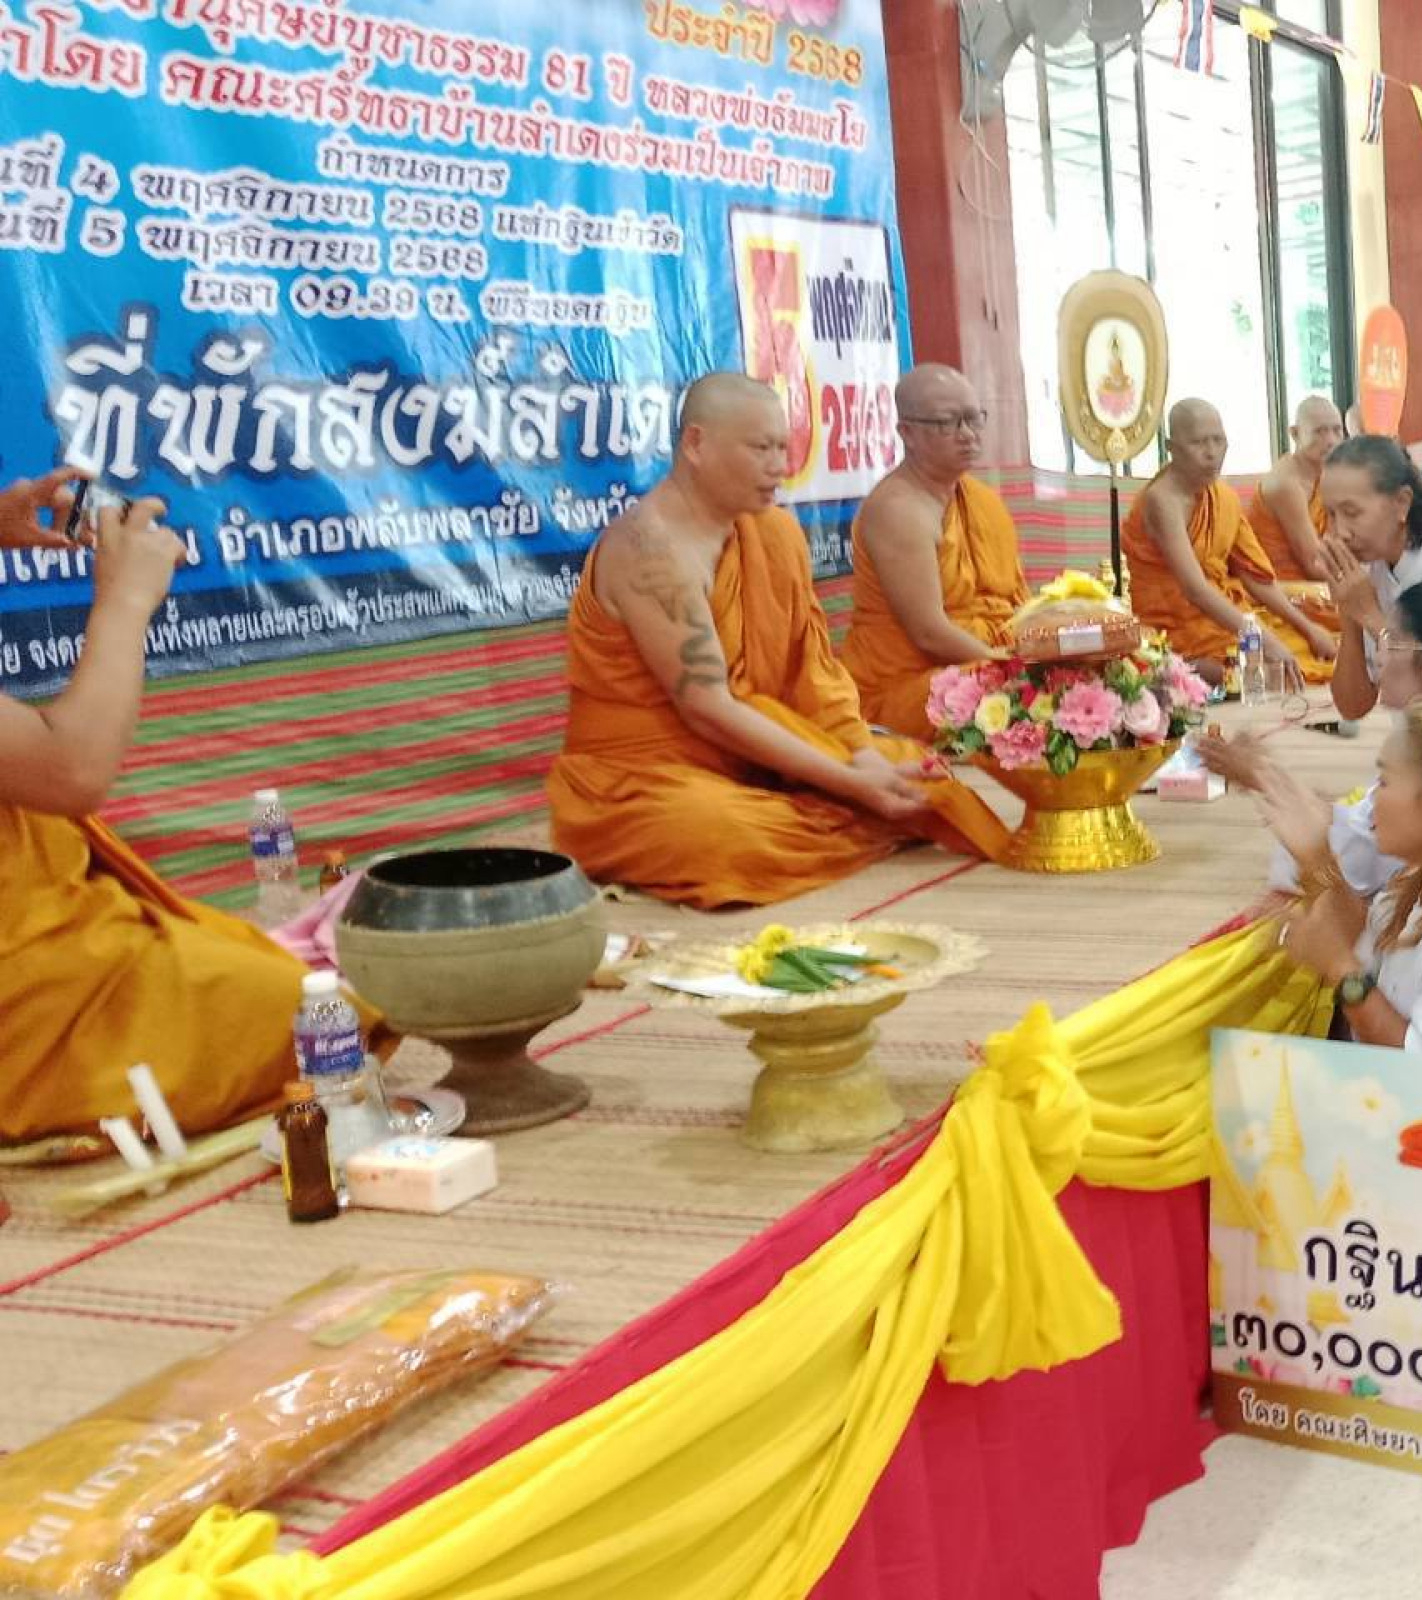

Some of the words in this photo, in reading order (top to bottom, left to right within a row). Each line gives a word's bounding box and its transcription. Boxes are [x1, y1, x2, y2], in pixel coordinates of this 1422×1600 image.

[645, 0, 775, 64] ประจำปี
[788, 34, 862, 85] 2568
[546, 54, 591, 95] 81
[606, 56, 632, 101] ปี
[322, 137, 506, 192] กำหนดการ
[80, 162, 108, 196] 4
[139, 171, 371, 221] พฤศจิกายน
[386, 195, 479, 231] 2568
[87, 217, 118, 247] 5
[145, 222, 377, 266] พฤศจิกายน
[394, 240, 484, 274] 2568
[189, 276, 275, 309] เวลา
[430, 292, 468, 319] น.
[53, 312, 683, 480] ที่พักสงฆ์ลำเด
[218, 490, 540, 562] อำเภอพลับพลาชัย
[1240, 1390, 1286, 1427] โดย
